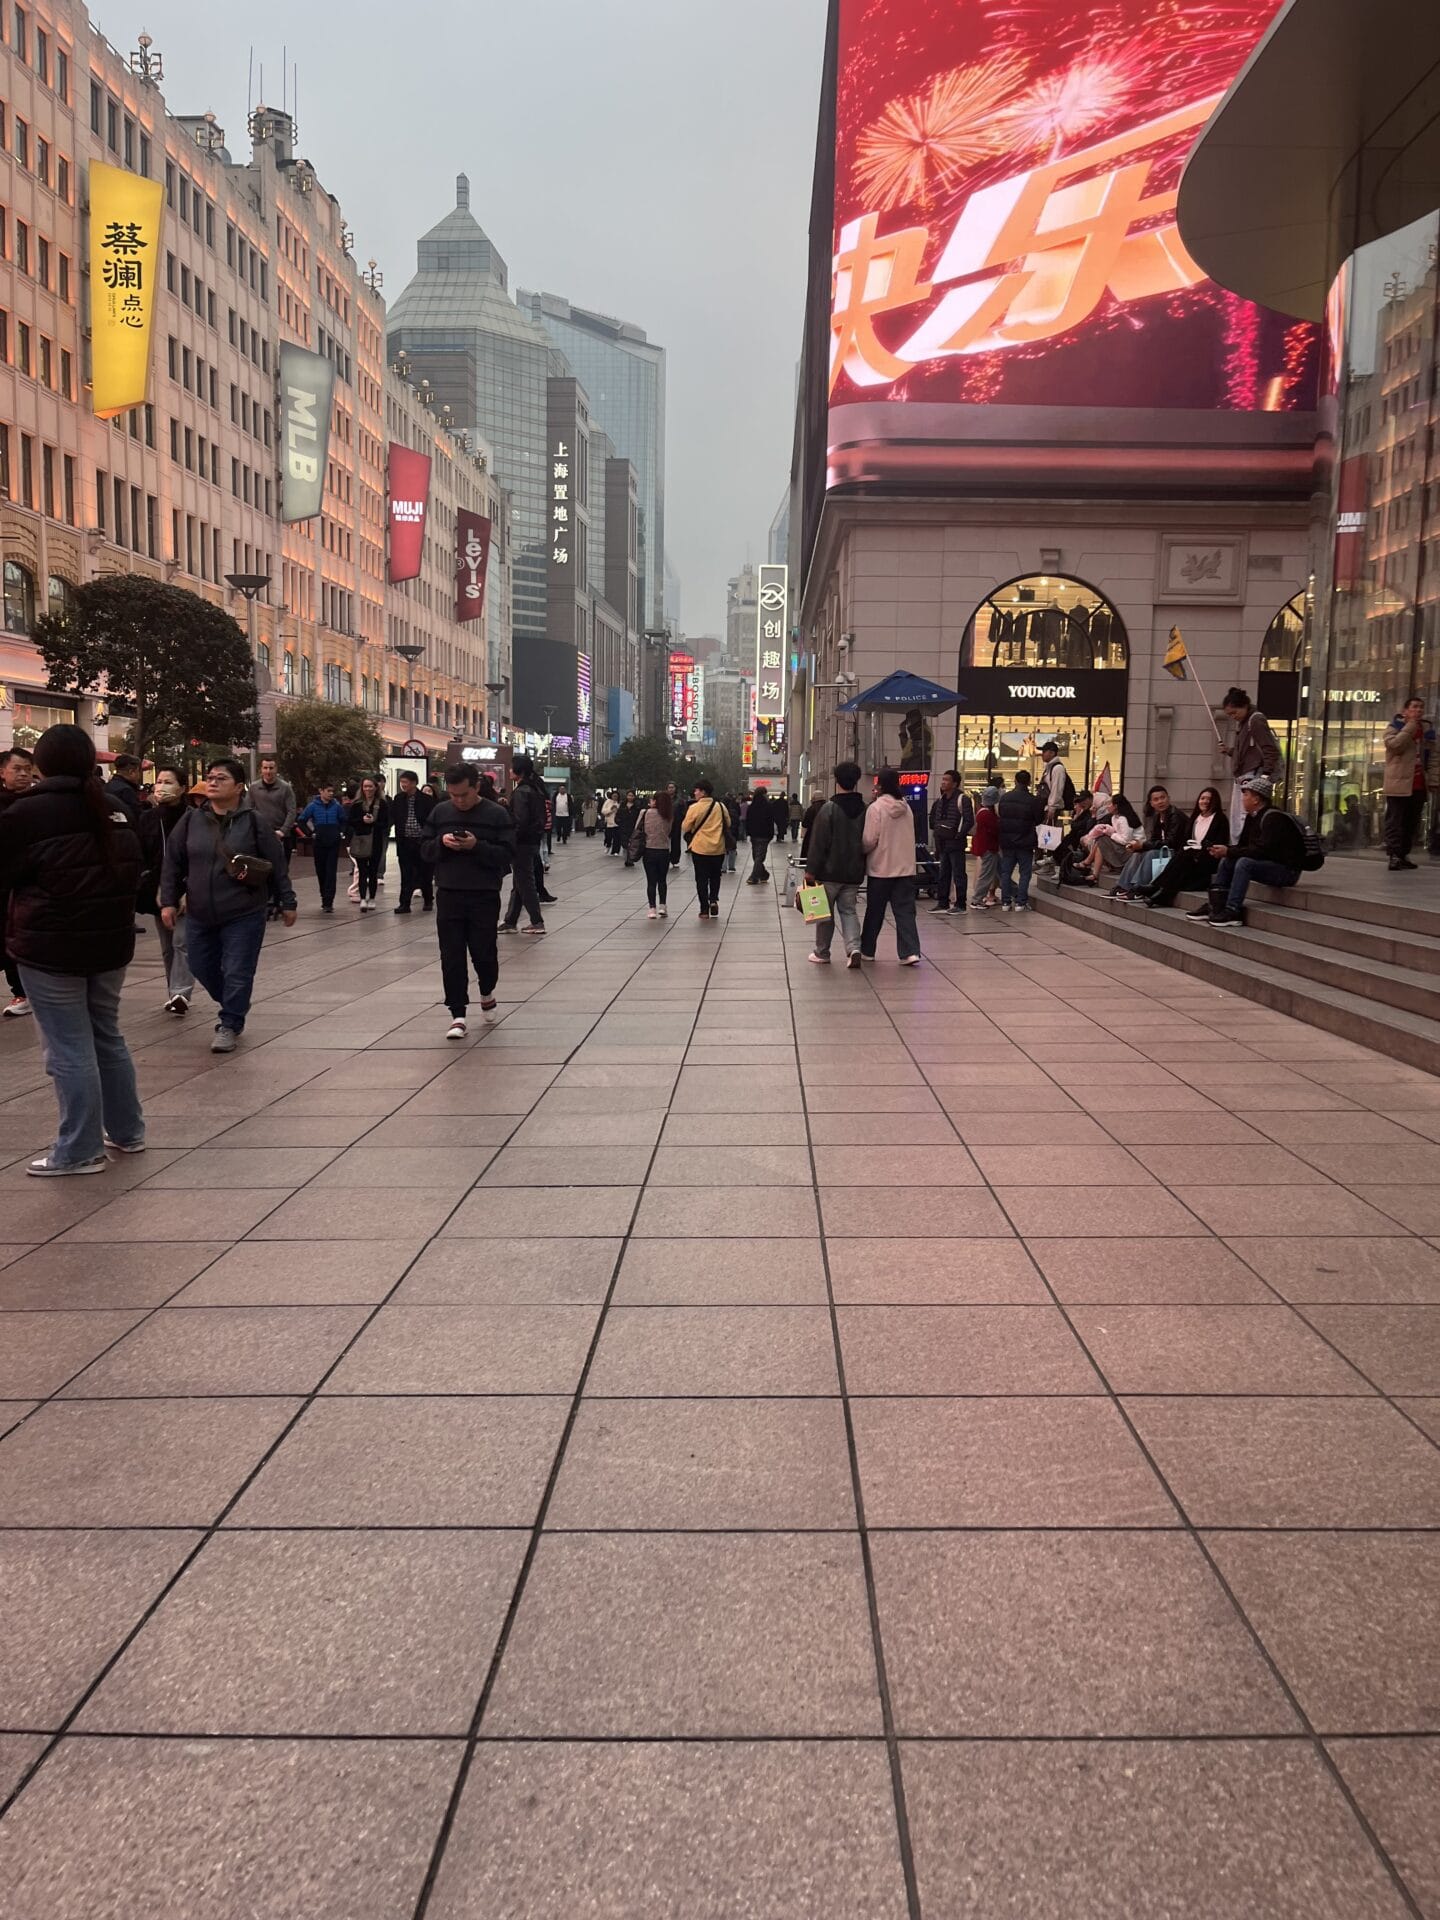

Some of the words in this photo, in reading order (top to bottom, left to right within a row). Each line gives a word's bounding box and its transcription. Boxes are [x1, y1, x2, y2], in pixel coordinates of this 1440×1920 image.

[287, 386, 318, 483] MLB
[392, 500, 423, 515] MUJI
[553, 441, 569, 564] 上海置地广场
[762, 619, 781, 700] 创趣场
[1008, 685, 1076, 699] YOUNGOR
[692, 677, 700, 734] BOSIDENG
